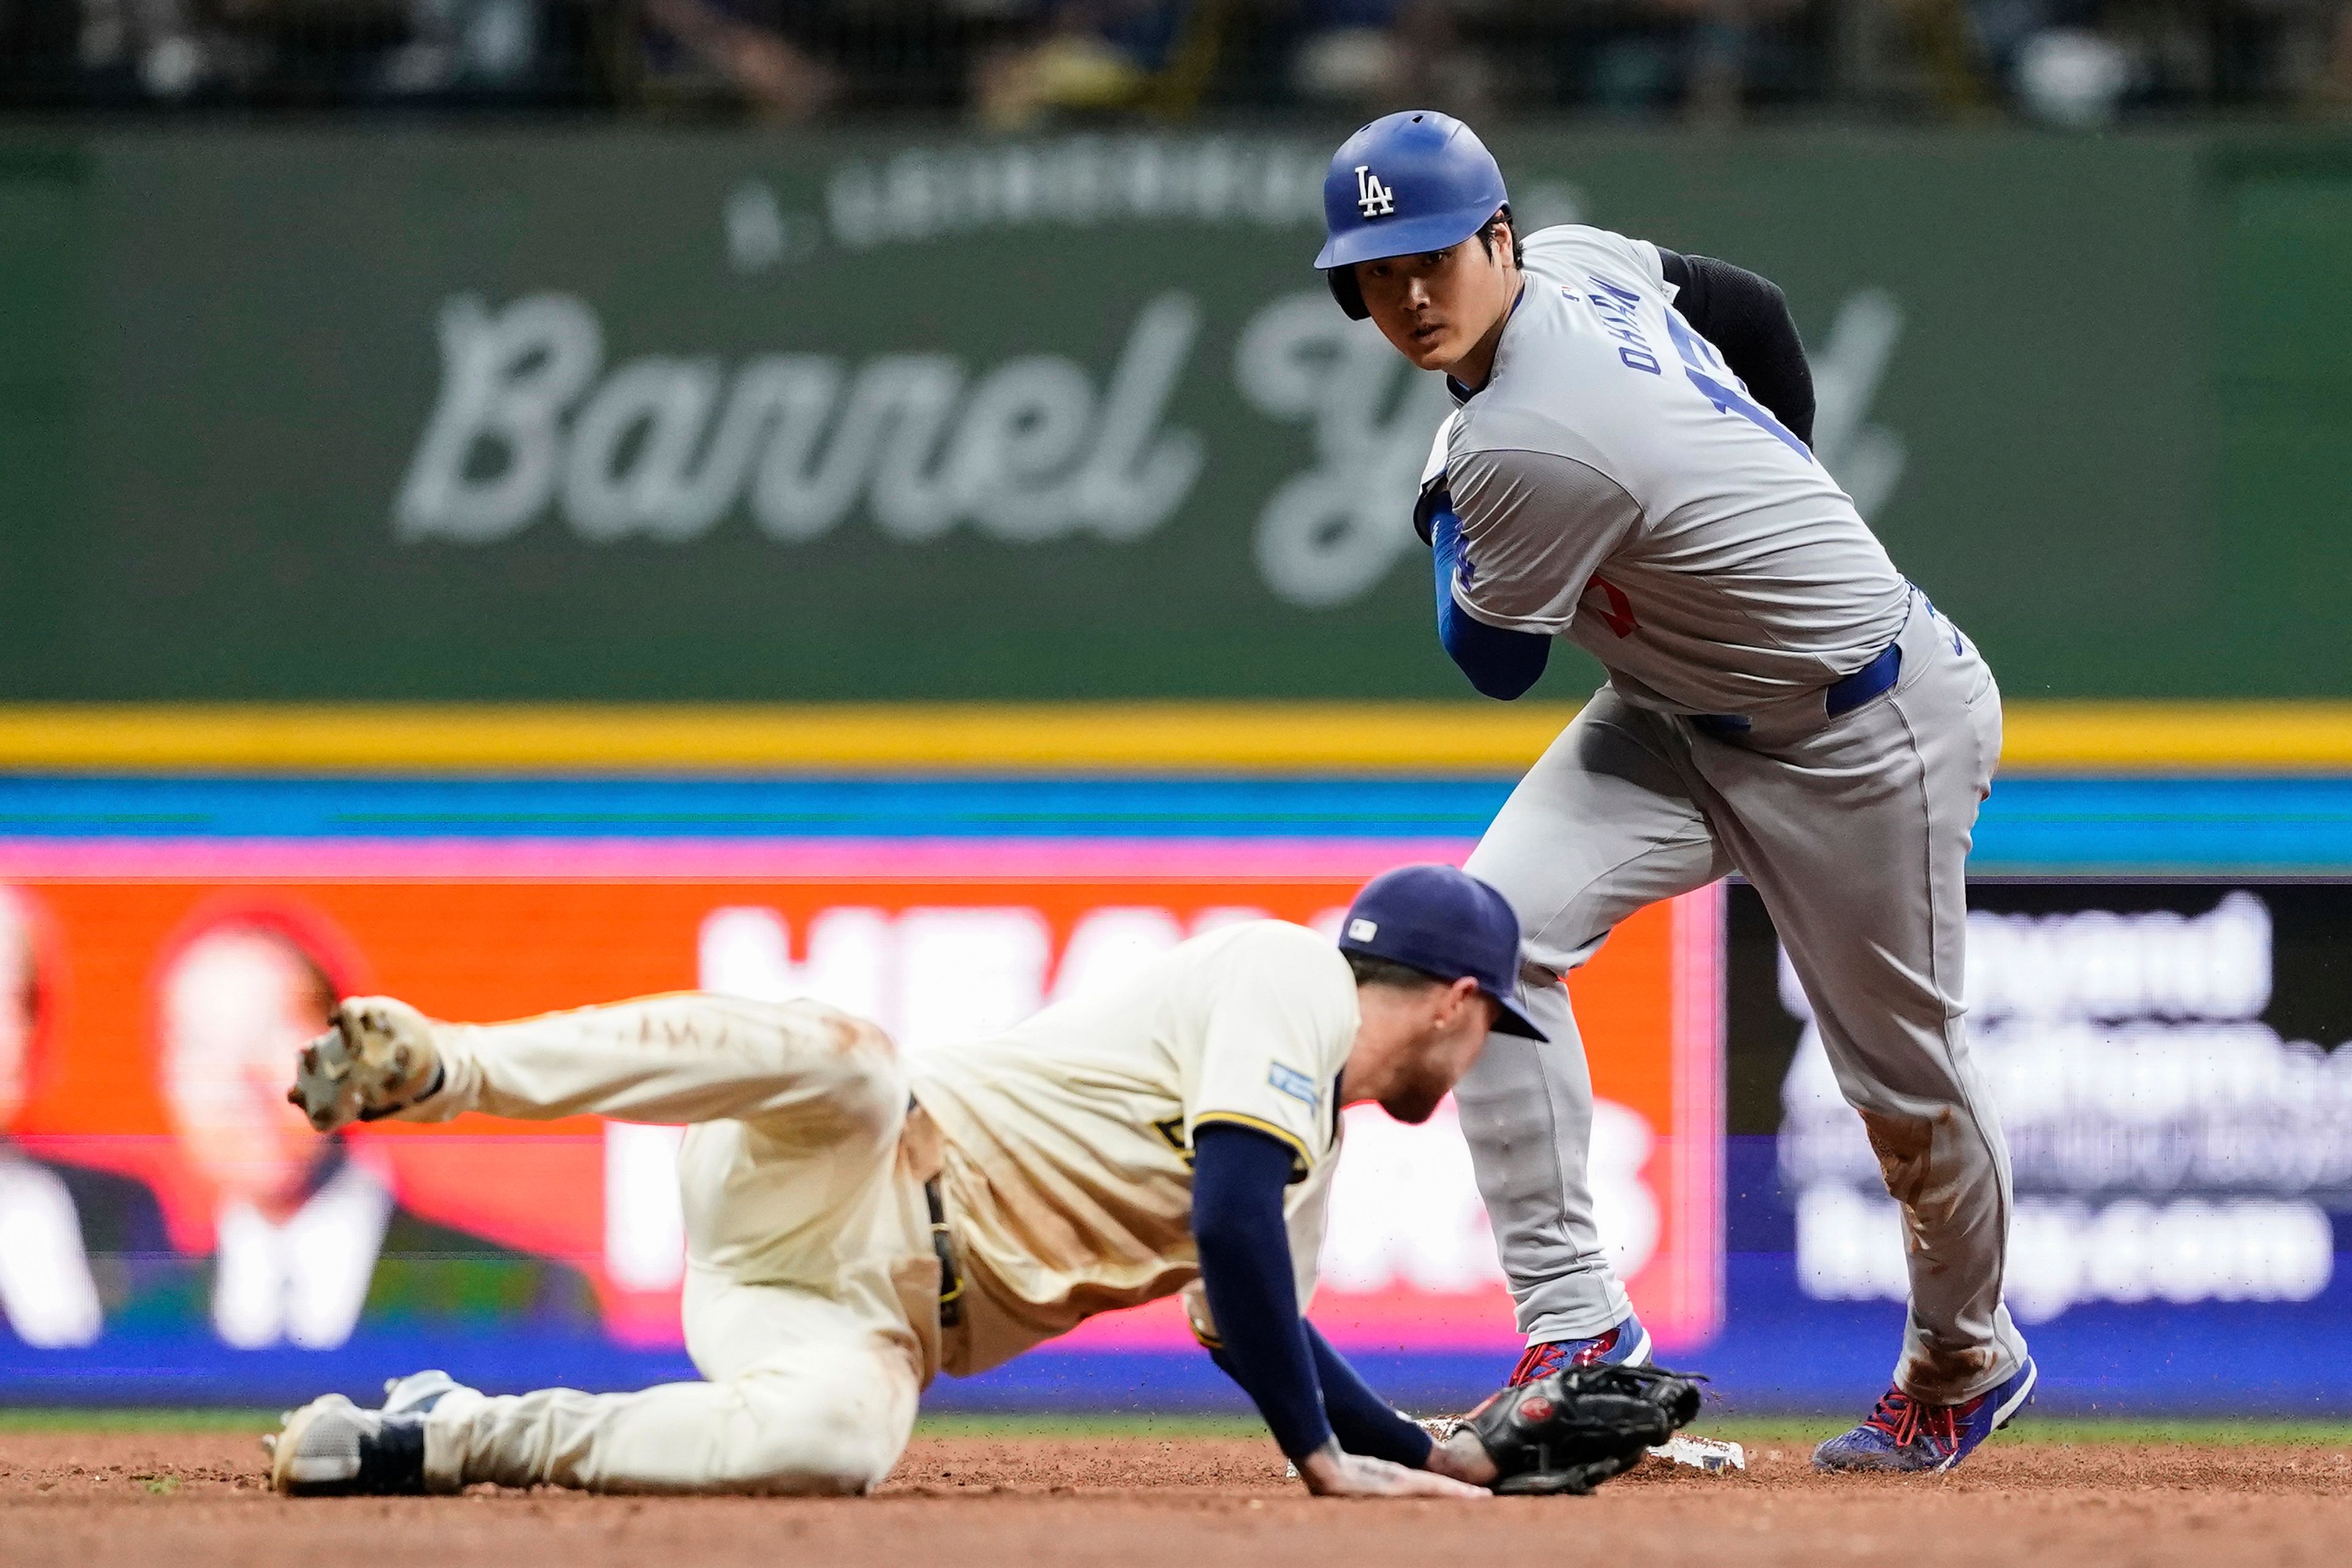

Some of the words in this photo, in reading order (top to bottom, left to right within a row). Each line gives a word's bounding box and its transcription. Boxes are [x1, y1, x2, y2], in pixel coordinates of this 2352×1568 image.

[1354, 165, 1394, 217] LA
[393, 290, 1204, 544] Barrel
[1663, 305, 1813, 466] 17
